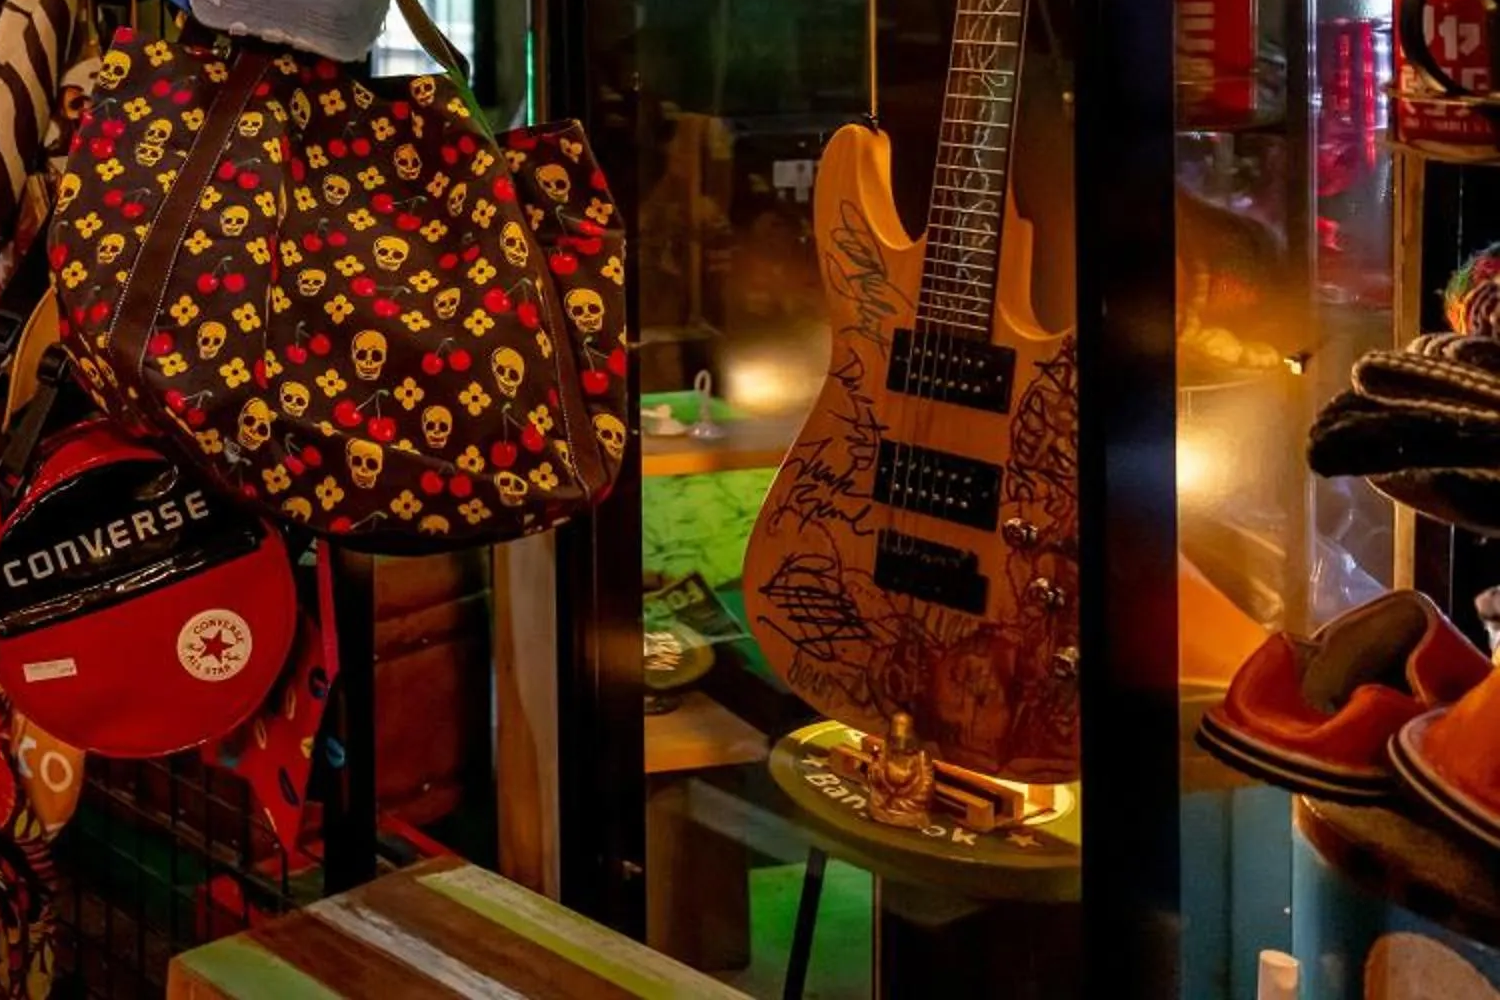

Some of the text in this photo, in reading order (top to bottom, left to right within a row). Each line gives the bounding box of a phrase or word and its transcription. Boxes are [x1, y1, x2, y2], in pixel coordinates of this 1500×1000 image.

[3, 490, 209, 588] CONVERSE
[193, 619, 244, 644] CONVERSE
[804, 772, 977, 846] Banok
